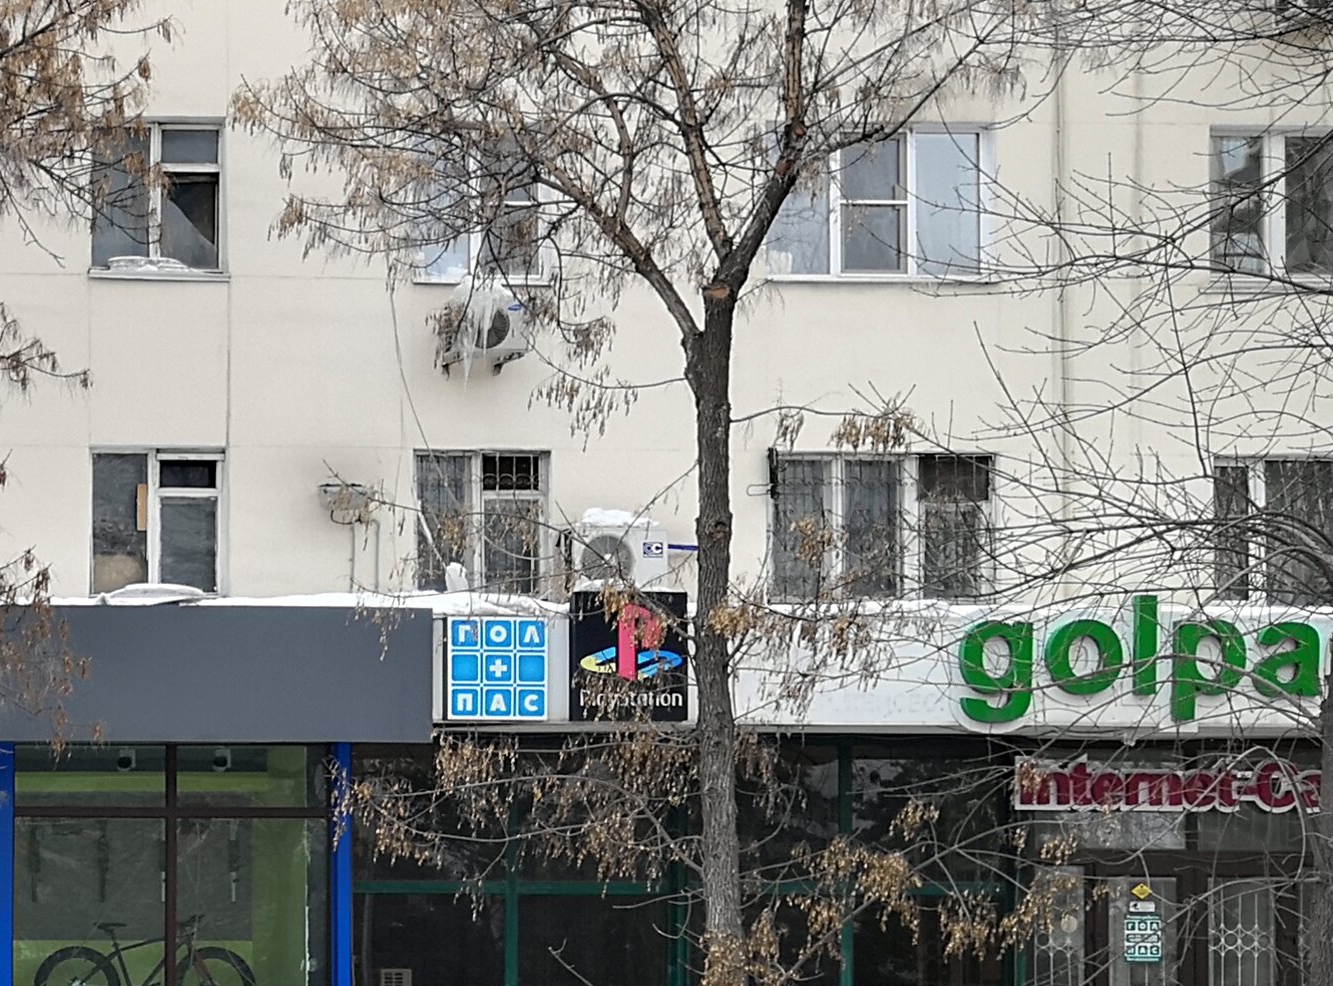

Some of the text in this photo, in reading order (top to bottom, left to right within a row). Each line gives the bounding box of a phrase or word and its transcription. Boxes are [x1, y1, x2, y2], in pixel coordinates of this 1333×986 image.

[458, 625, 540, 643] ГОЛ
[960, 594, 1321, 723] golpa
[457, 693, 539, 712] ПАС
[579, 688, 683, 711] PayStation
